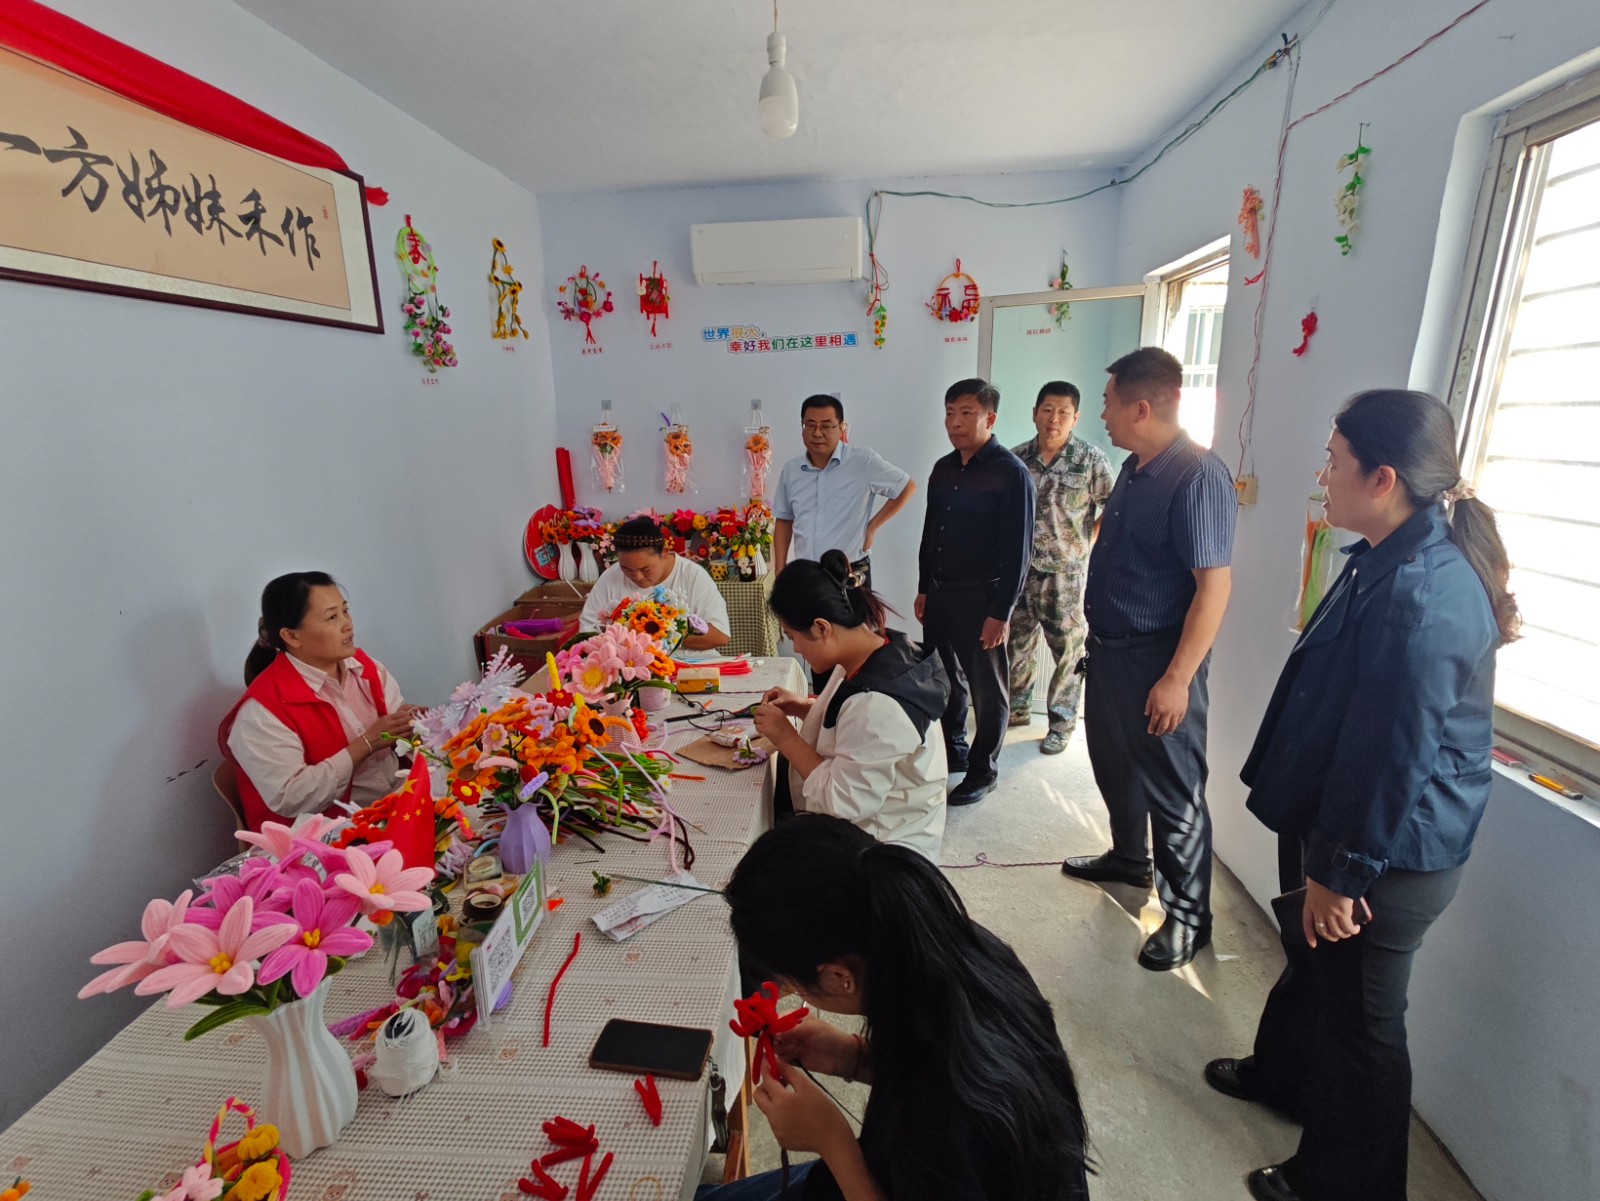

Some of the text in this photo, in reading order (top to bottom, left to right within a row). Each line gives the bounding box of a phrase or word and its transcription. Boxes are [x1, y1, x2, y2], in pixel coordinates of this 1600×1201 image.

[729, 333, 857, 352] 幸好我们在这里相遇
